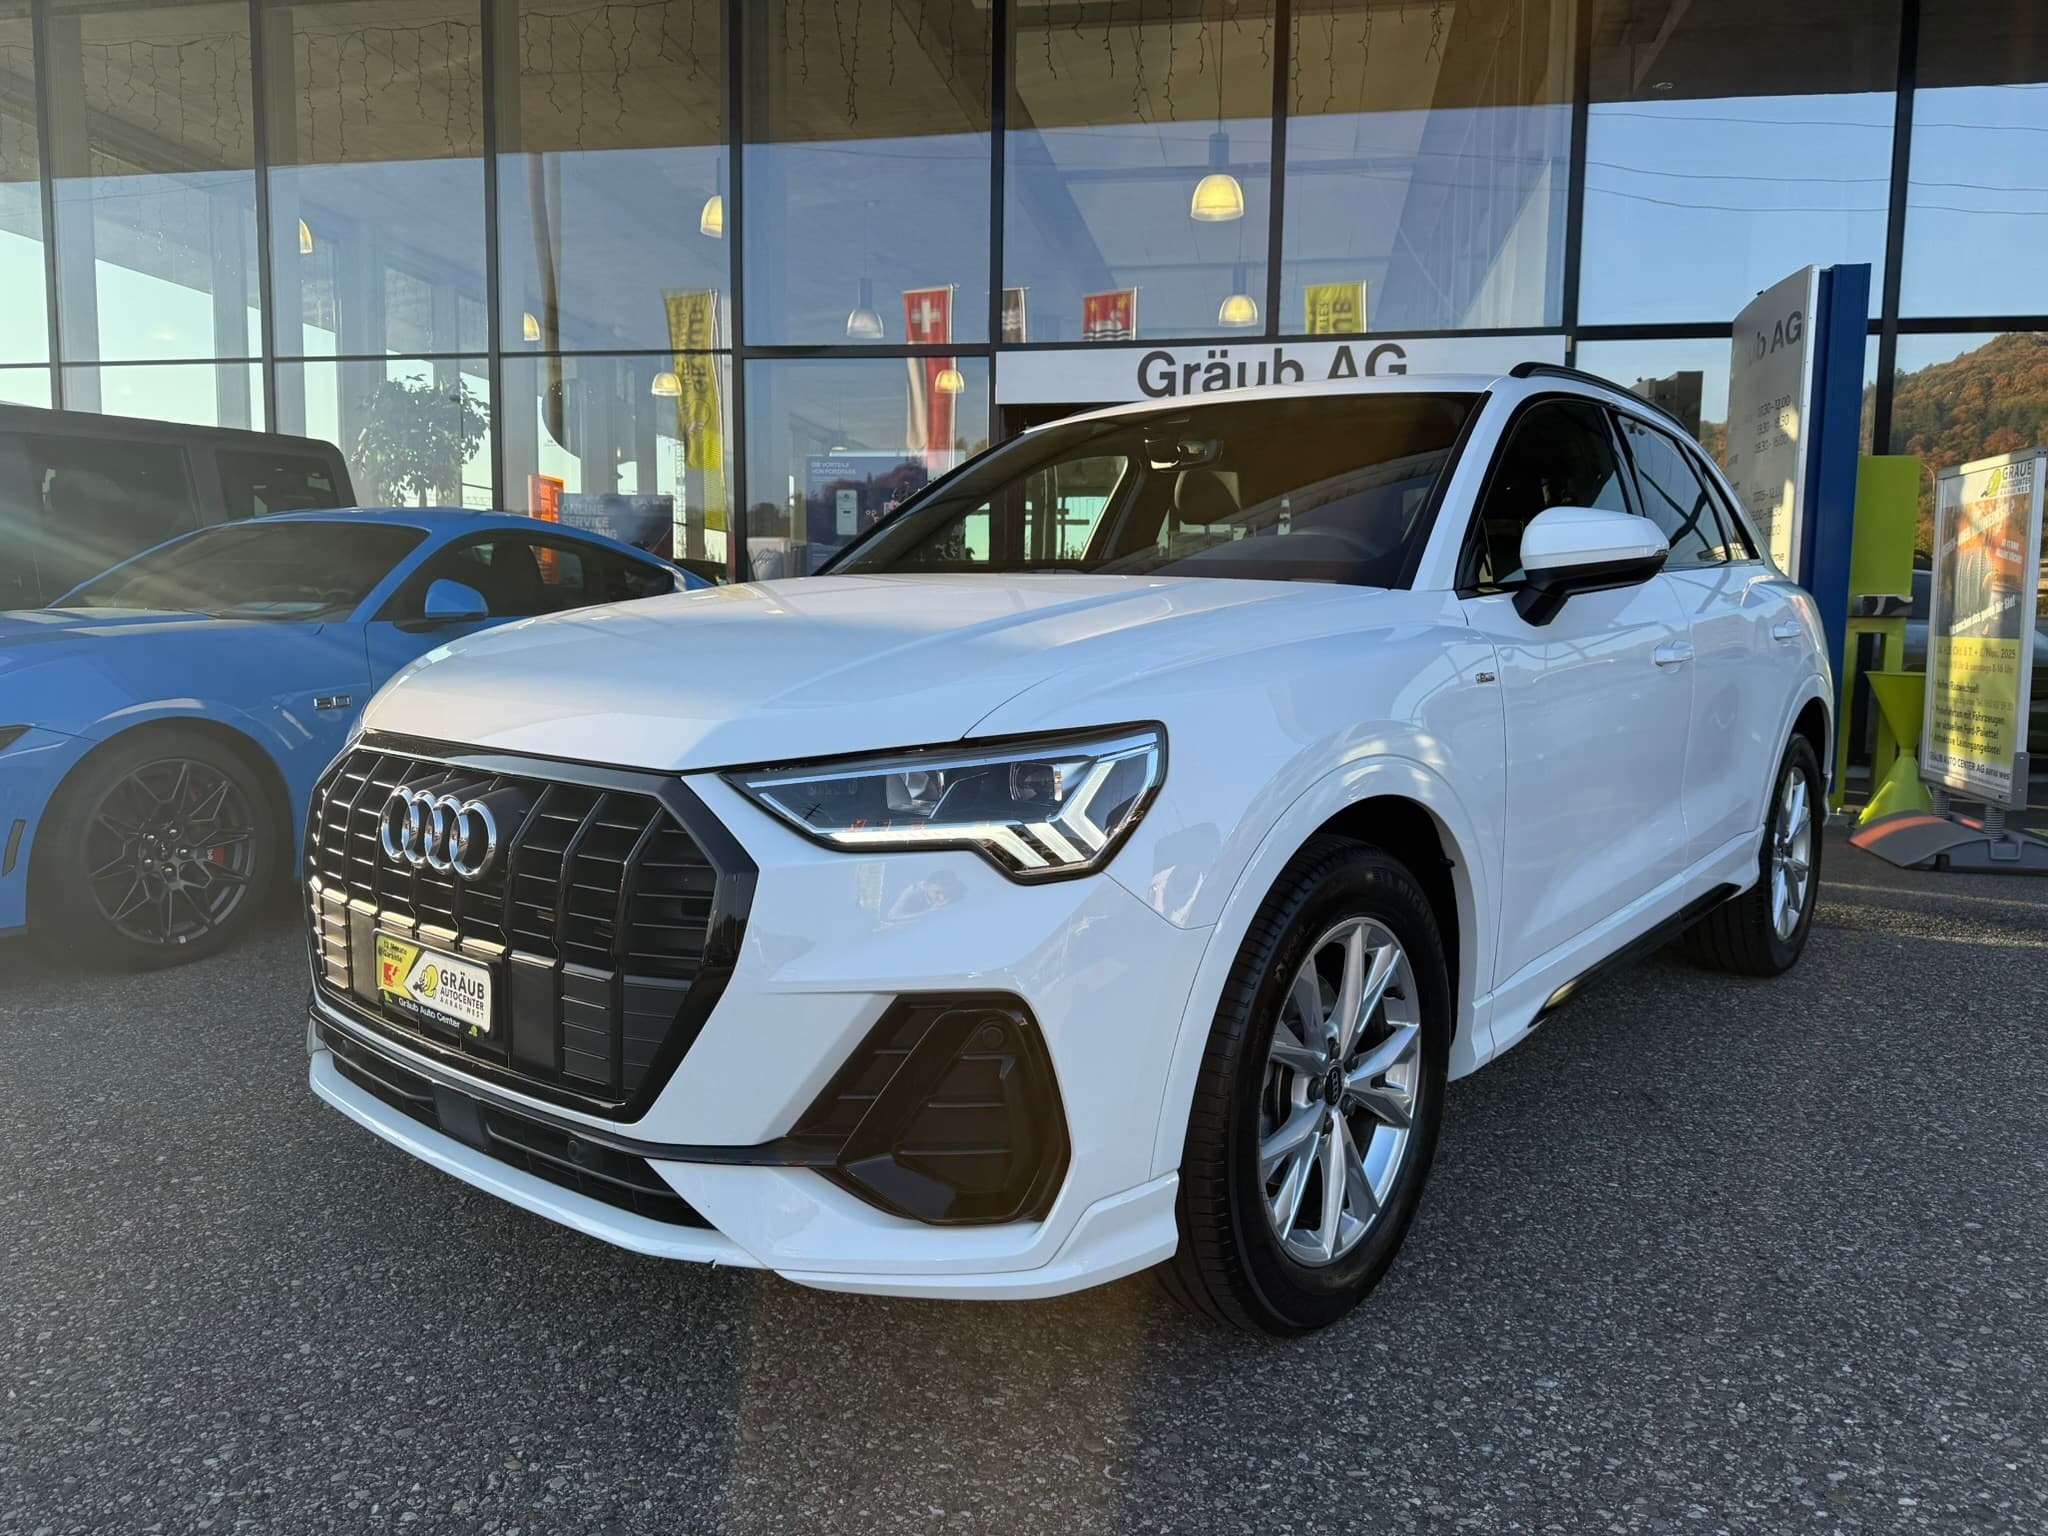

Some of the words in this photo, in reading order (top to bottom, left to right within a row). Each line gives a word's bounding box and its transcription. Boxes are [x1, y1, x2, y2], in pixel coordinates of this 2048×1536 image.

[1137, 347, 1304, 398] Gräub
[1327, 343, 1408, 379] AG
[561, 503, 605, 514] ONLINE
[561, 516, 609, 528] SERVICE
[440, 969, 485, 1000] GRÄUB
[440, 987, 484, 1011] AUTOCENTER
[420, 1005, 436, 1019] Auto
[436, 1012, 461, 1029] Center
[466, 1006, 484, 1020] WEST
